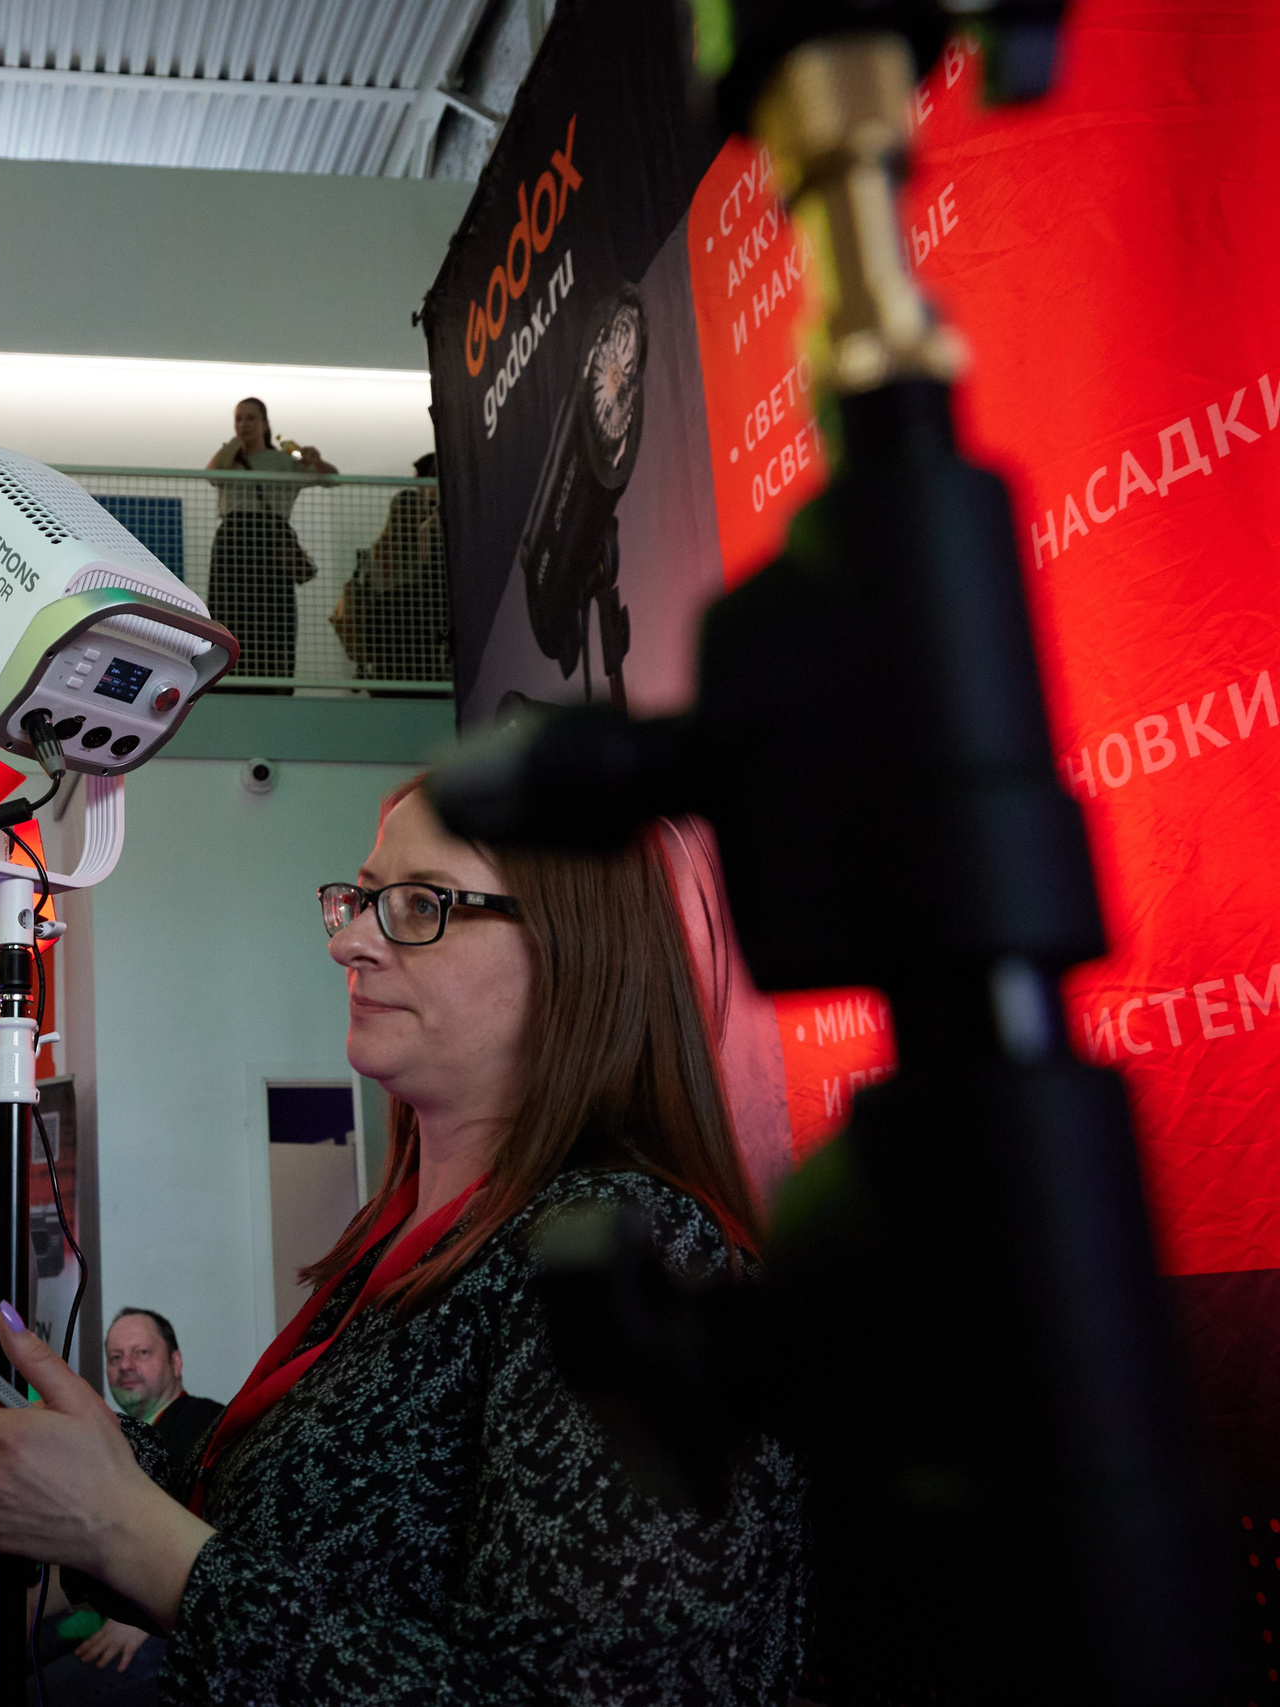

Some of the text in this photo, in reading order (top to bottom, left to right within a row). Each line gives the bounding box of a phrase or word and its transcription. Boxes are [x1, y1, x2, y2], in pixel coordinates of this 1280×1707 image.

[465, 112, 584, 377] Godox
[732, 311, 748, 354] И
[483, 249, 575, 440] godox.ru
